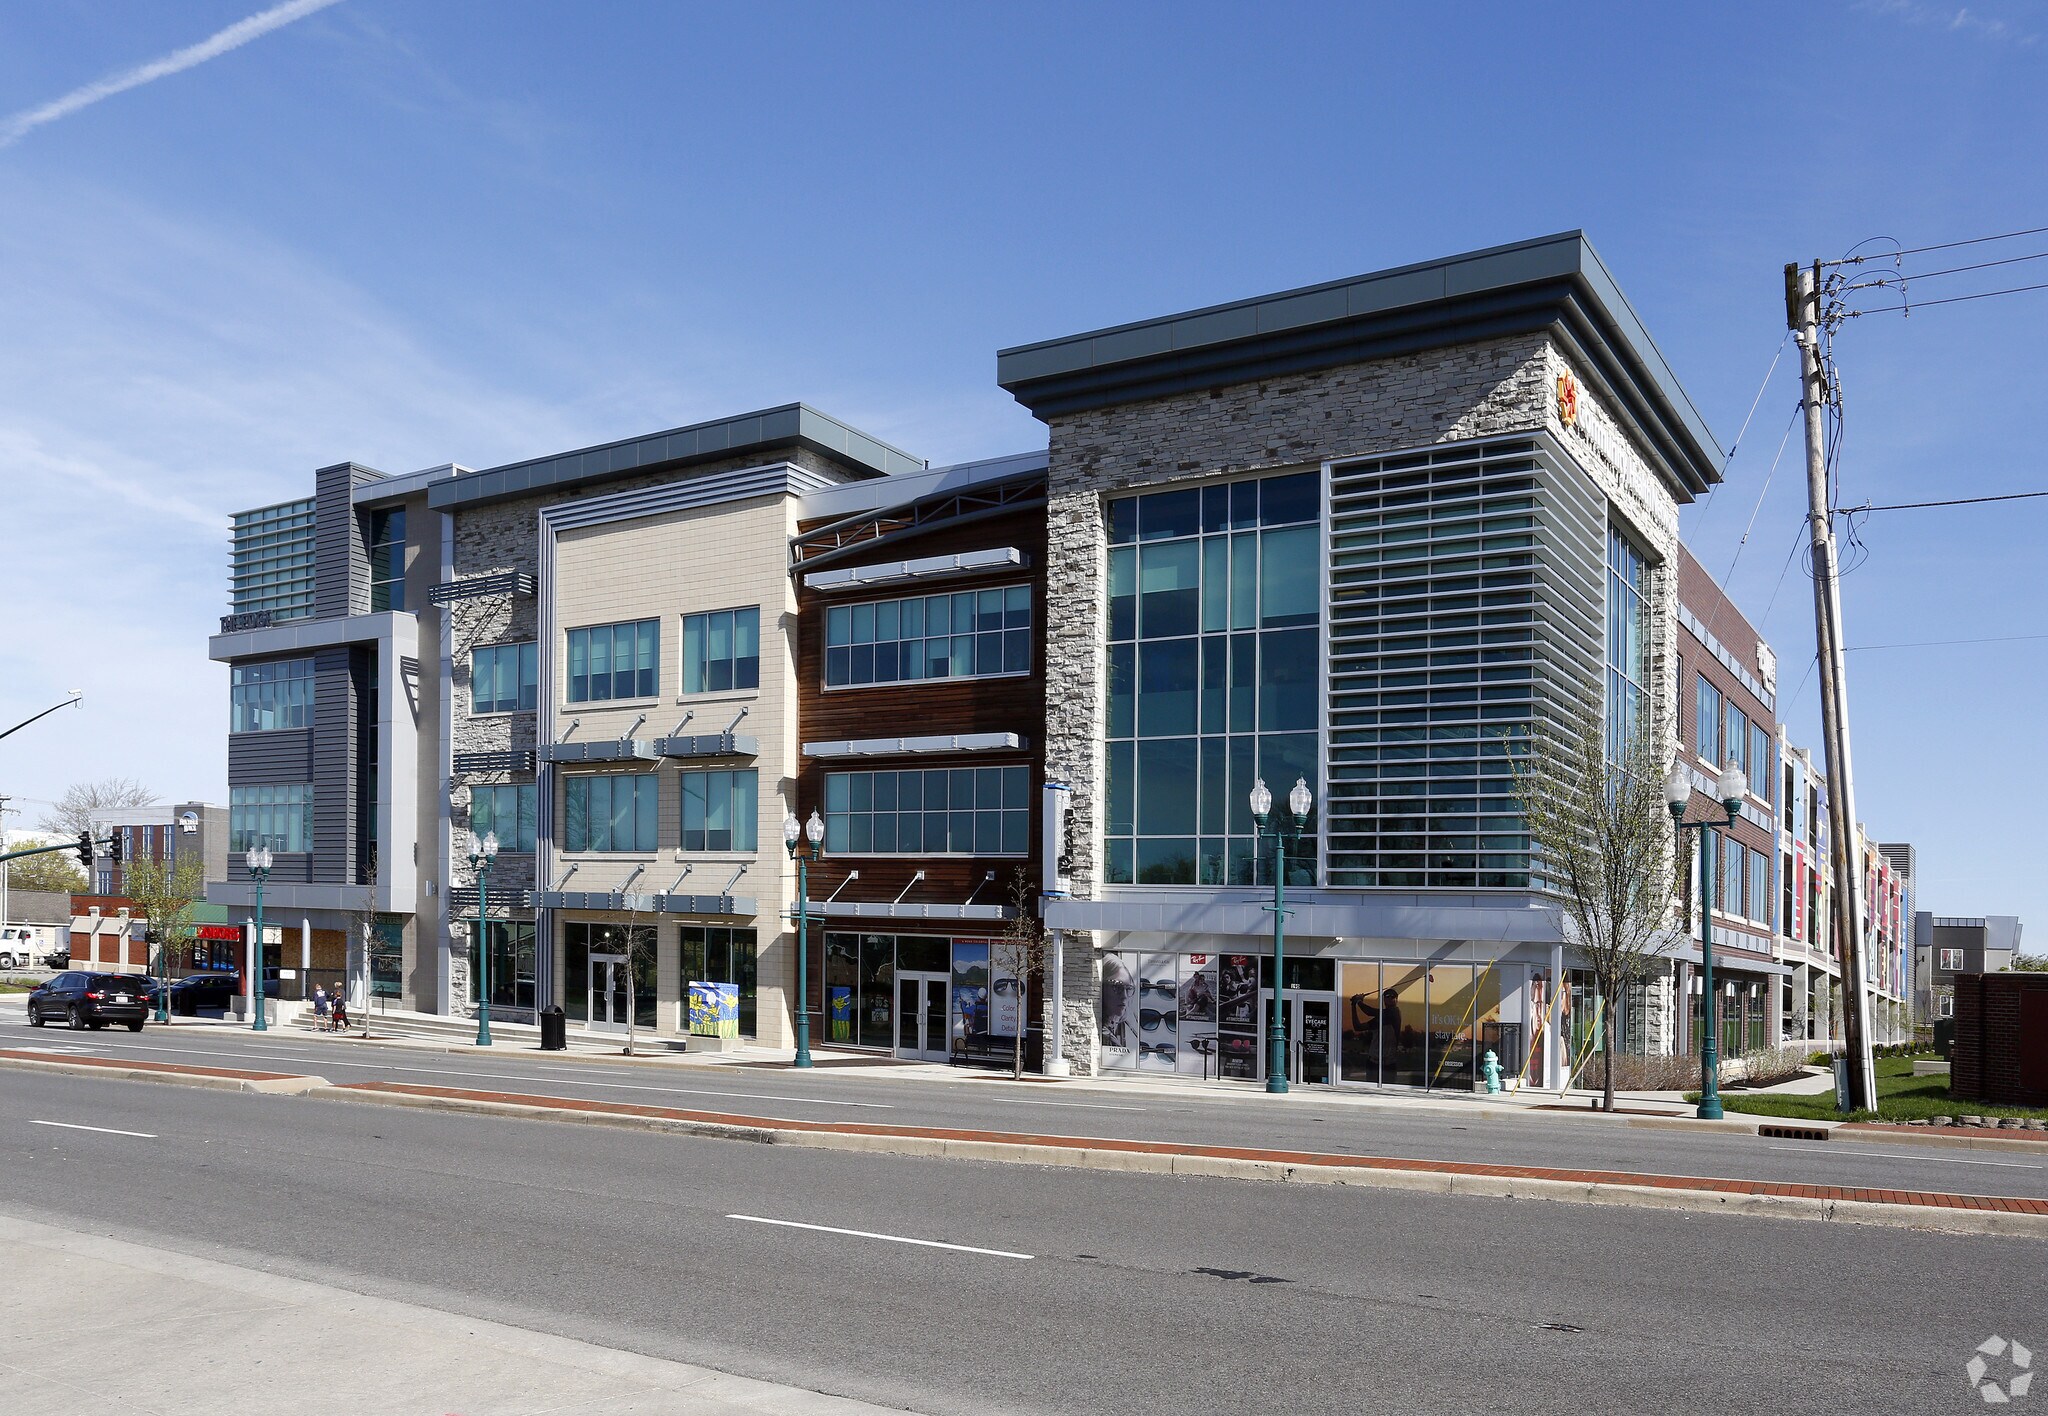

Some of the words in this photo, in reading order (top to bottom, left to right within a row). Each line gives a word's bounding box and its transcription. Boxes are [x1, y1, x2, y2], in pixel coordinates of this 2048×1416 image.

[1002, 1004, 1015, 1012] Color
[1001, 1014, 1016, 1023] Clarity
[1432, 1014, 1443, 1025] It's
[1444, 1014, 1456, 1025] OK
[1435, 1031, 1450, 1042] stay
